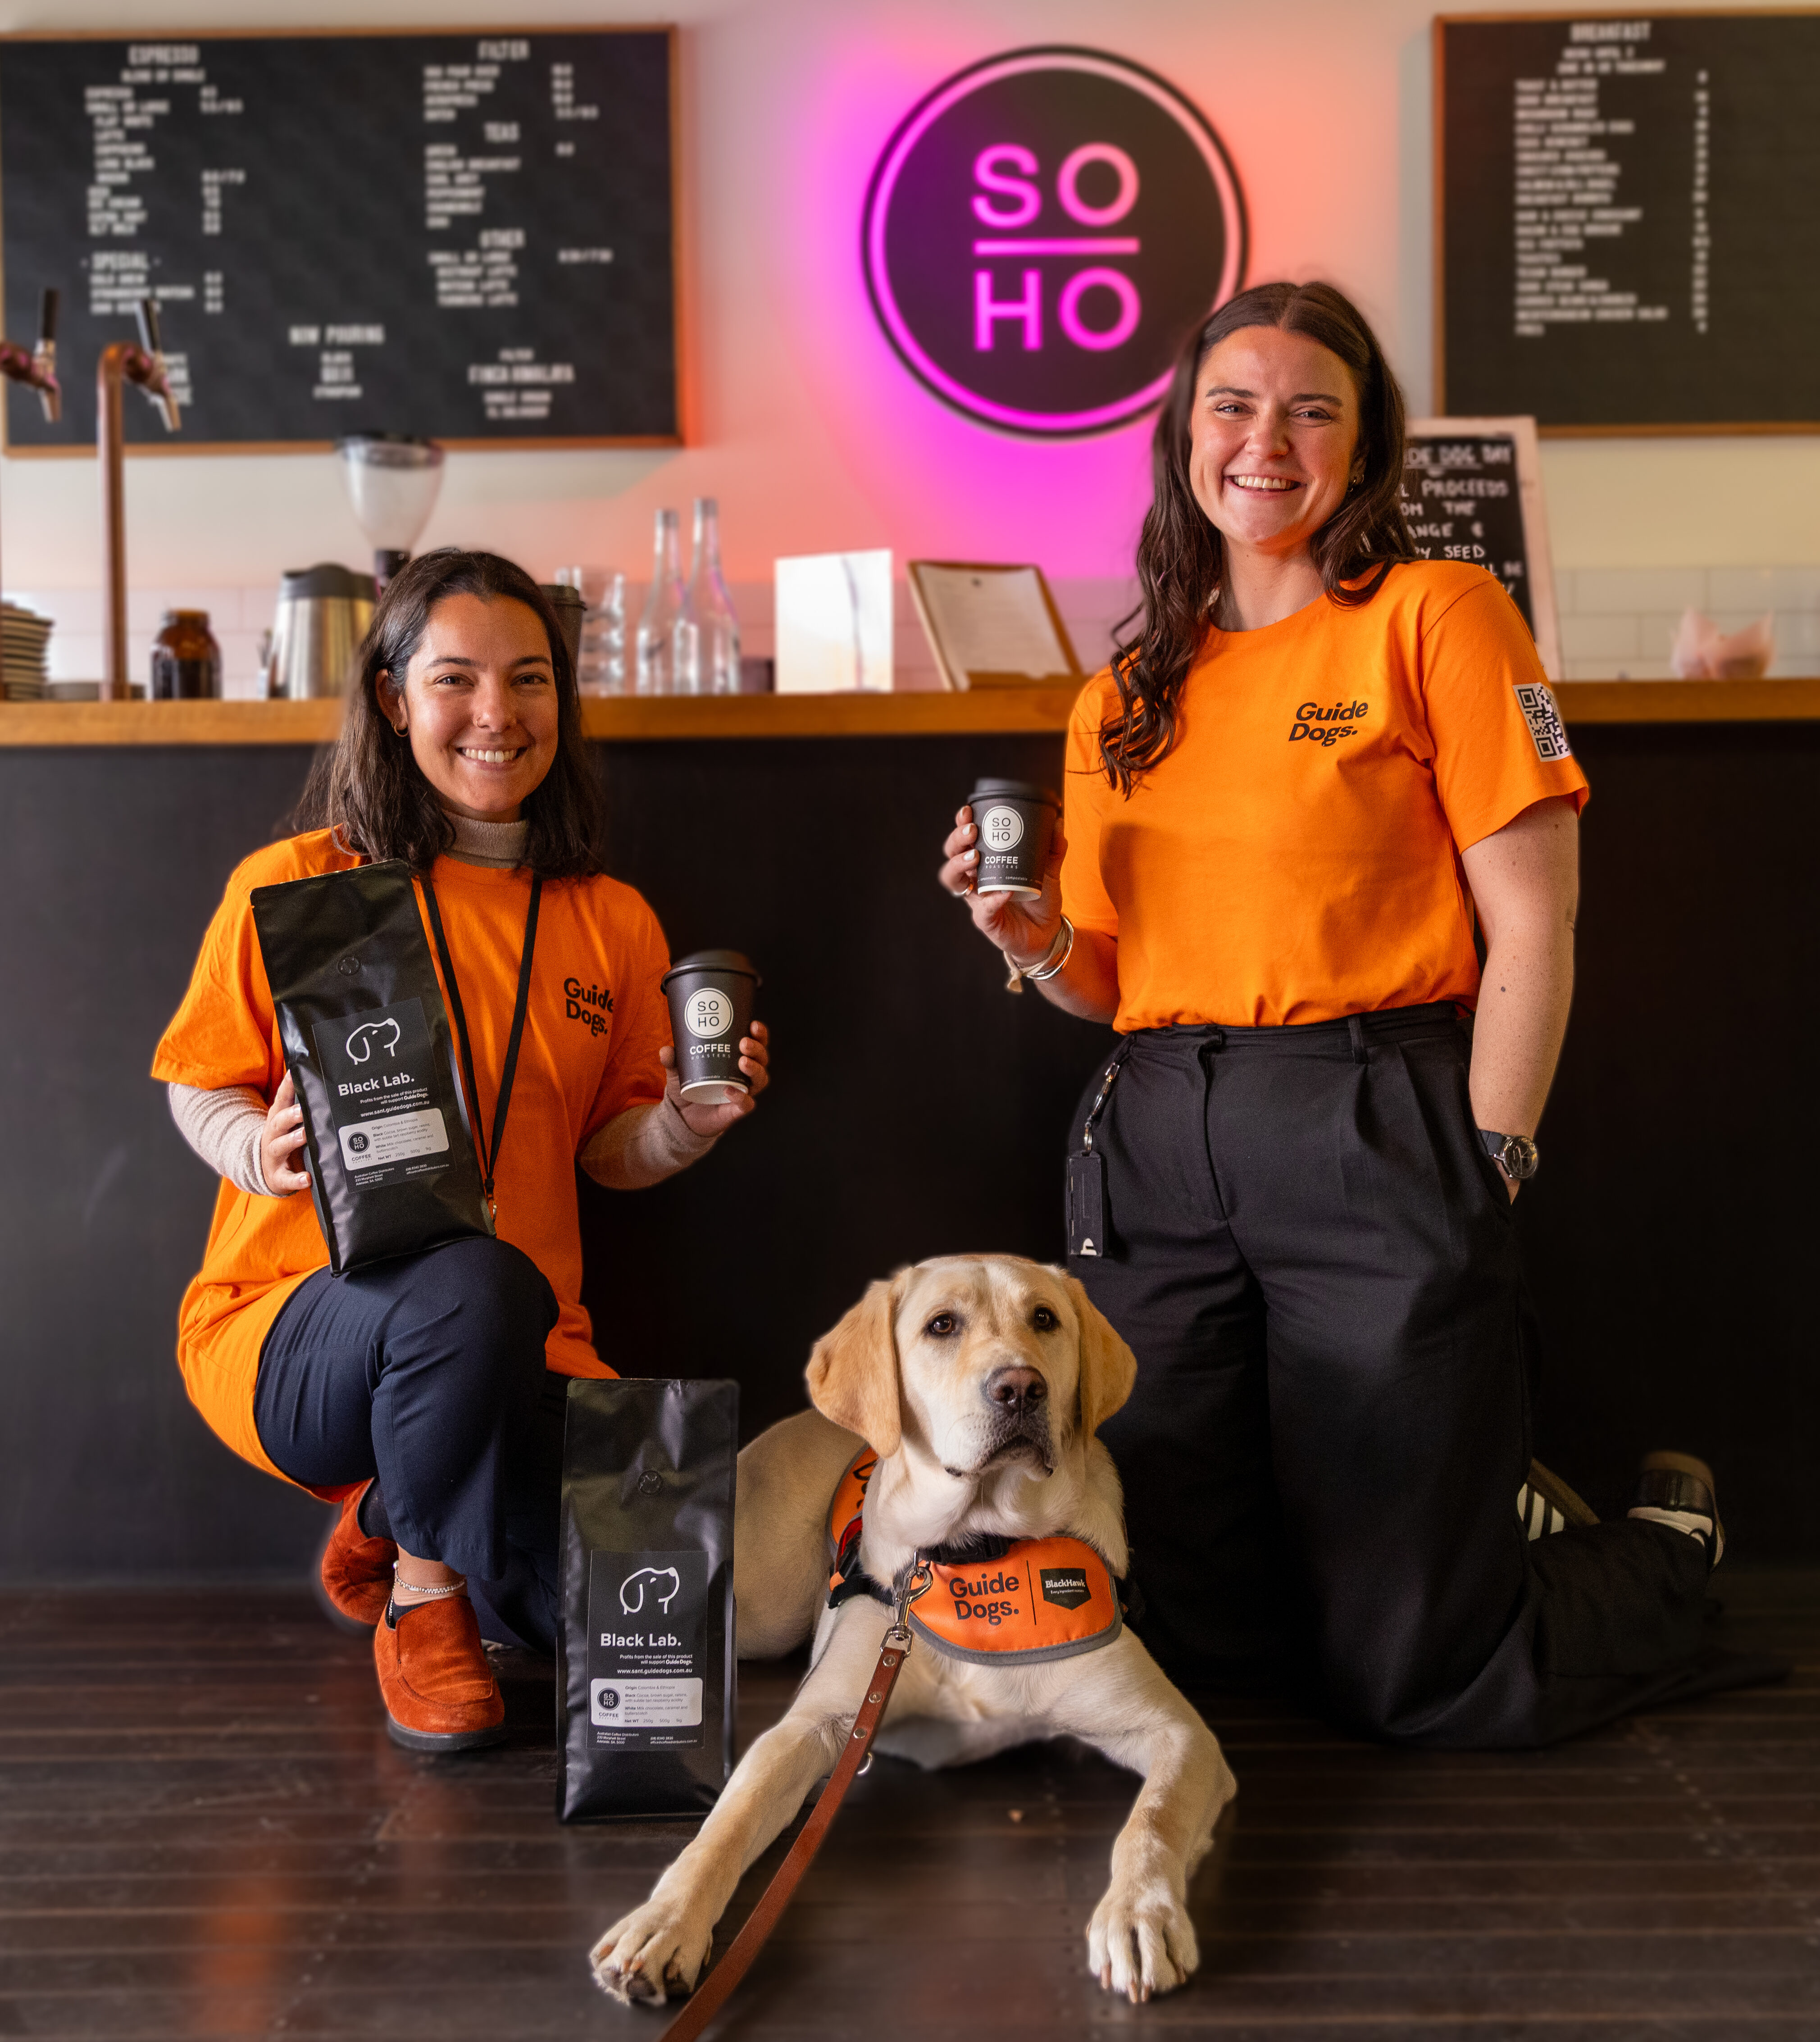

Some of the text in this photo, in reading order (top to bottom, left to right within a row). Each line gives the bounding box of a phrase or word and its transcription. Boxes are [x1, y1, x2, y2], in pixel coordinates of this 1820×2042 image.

[971, 142, 1139, 228] SO
[974, 267, 1140, 351] HO
[1421, 478, 1510, 497] PROCEEDS
[1442, 500, 1476, 516] THE
[1444, 545, 1485, 559] SEED
[1296, 700, 1369, 721] Guide
[1288, 723, 1358, 746] Dogs.
[992, 818, 1011, 827] SO
[992, 832, 1010, 841] HO
[985, 856, 1018, 864] COFFEE
[697, 1001, 719, 1012] SO
[566, 998, 608, 1037] Dogs.
[698, 1016, 719, 1028] HO
[690, 1044, 731, 1055] COFFEE
[337, 1073, 414, 1096] Black Lab.
[360, 1101, 430, 1116] www.sant.guidedogs.com.au
[949, 1572, 1019, 1598] Guide
[1045, 1578, 1085, 1588] BlackHawk
[954, 1599, 1019, 1626] Dogs.
[601, 1633, 681, 1646] Black Lab.
